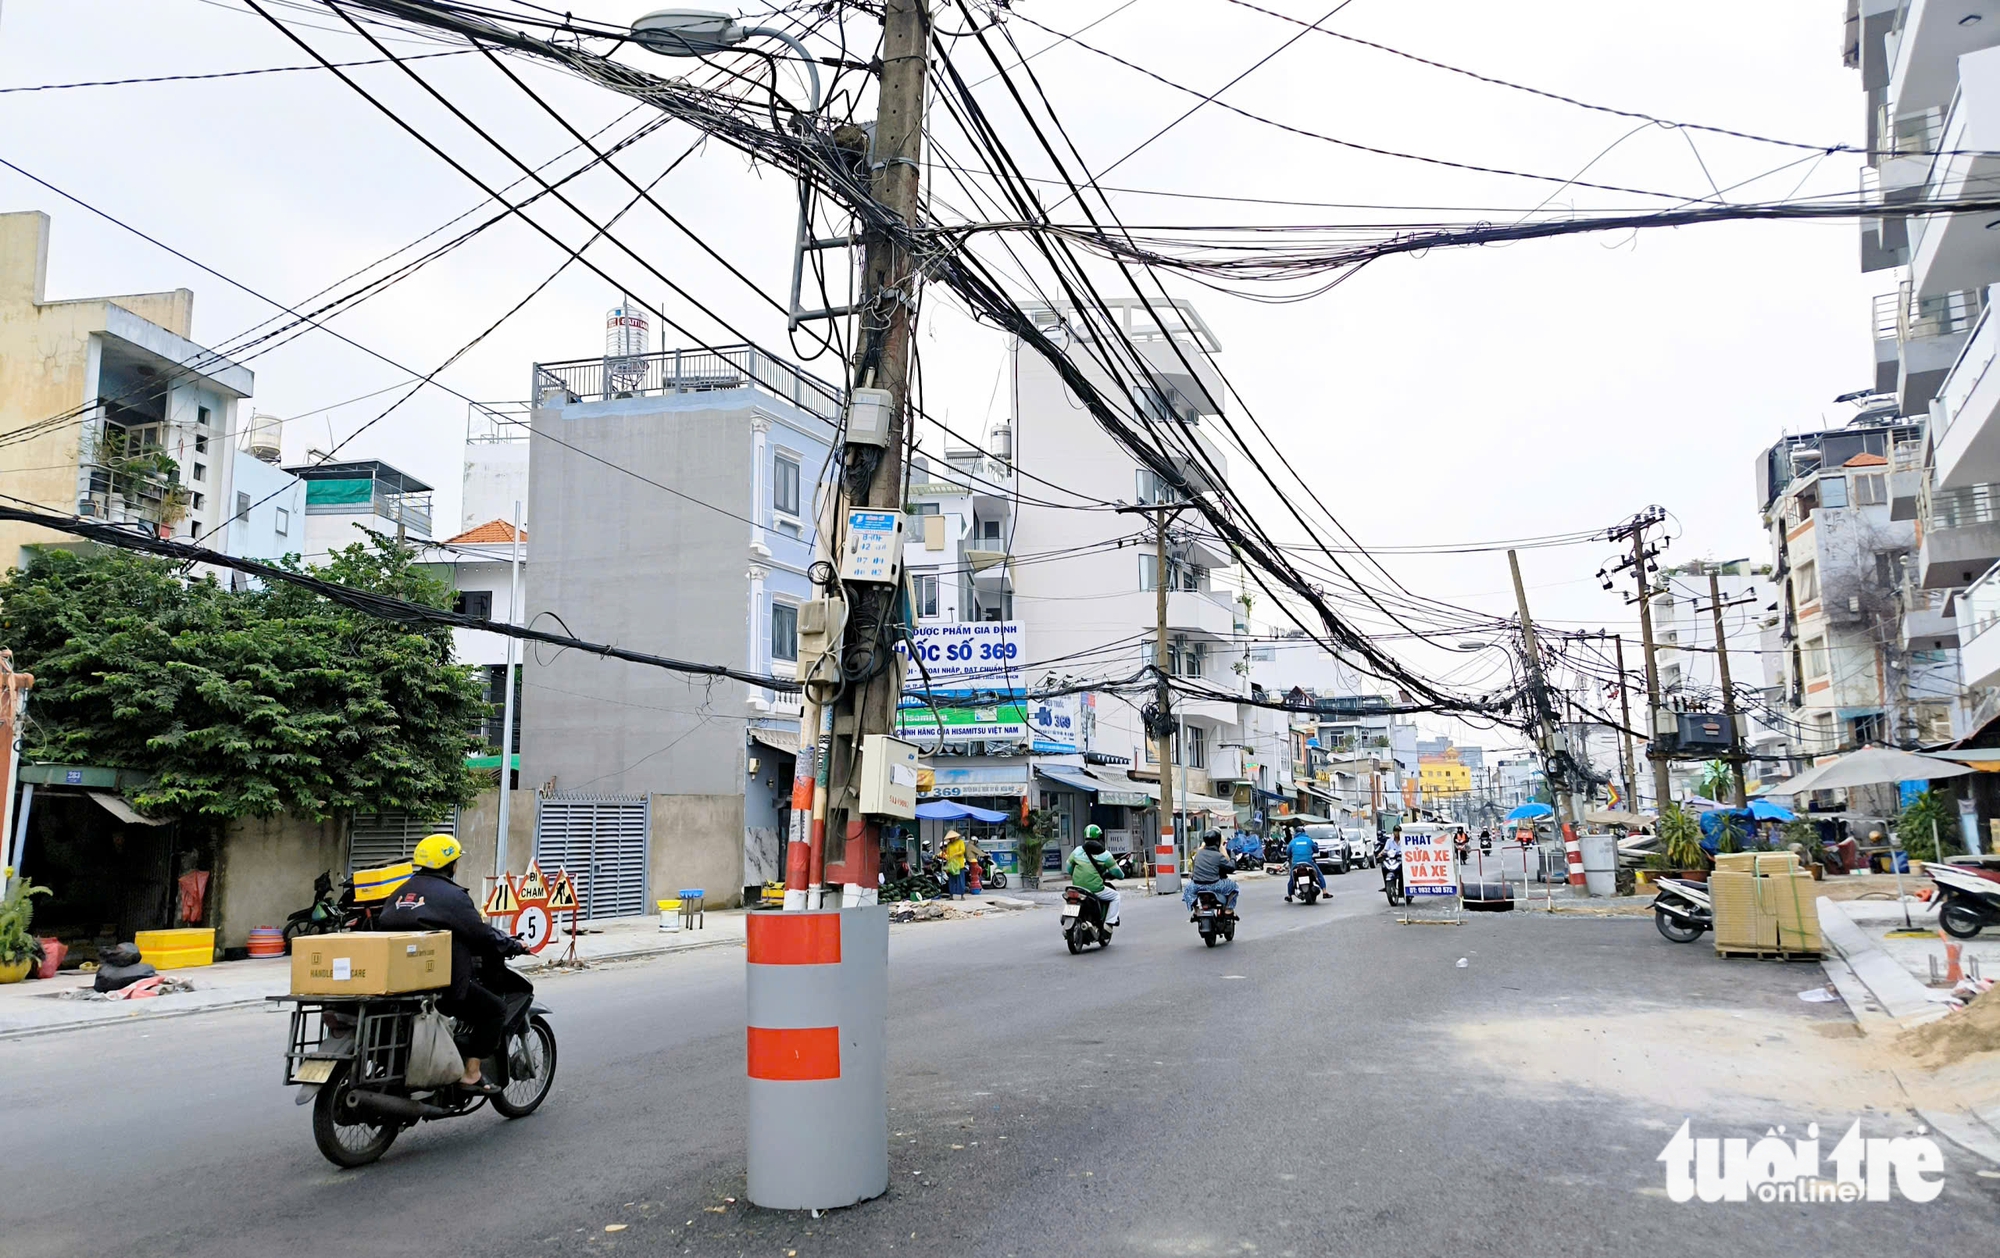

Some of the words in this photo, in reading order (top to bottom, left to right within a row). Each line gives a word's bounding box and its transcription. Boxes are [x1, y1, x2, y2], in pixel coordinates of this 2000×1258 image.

[943, 624, 971, 635] PHẨM
[946, 637, 973, 661] SỐ
[979, 643, 1017, 660] 369
[988, 726, 1002, 735] VIỆT
[933, 787, 961, 797] 369
[1404, 847, 1431, 862] SỬA
[1433, 850, 1450, 862] XE
[1410, 863, 1428, 877] VÁ
[1431, 865, 1448, 877] XE
[528, 916, 536, 939] 5
